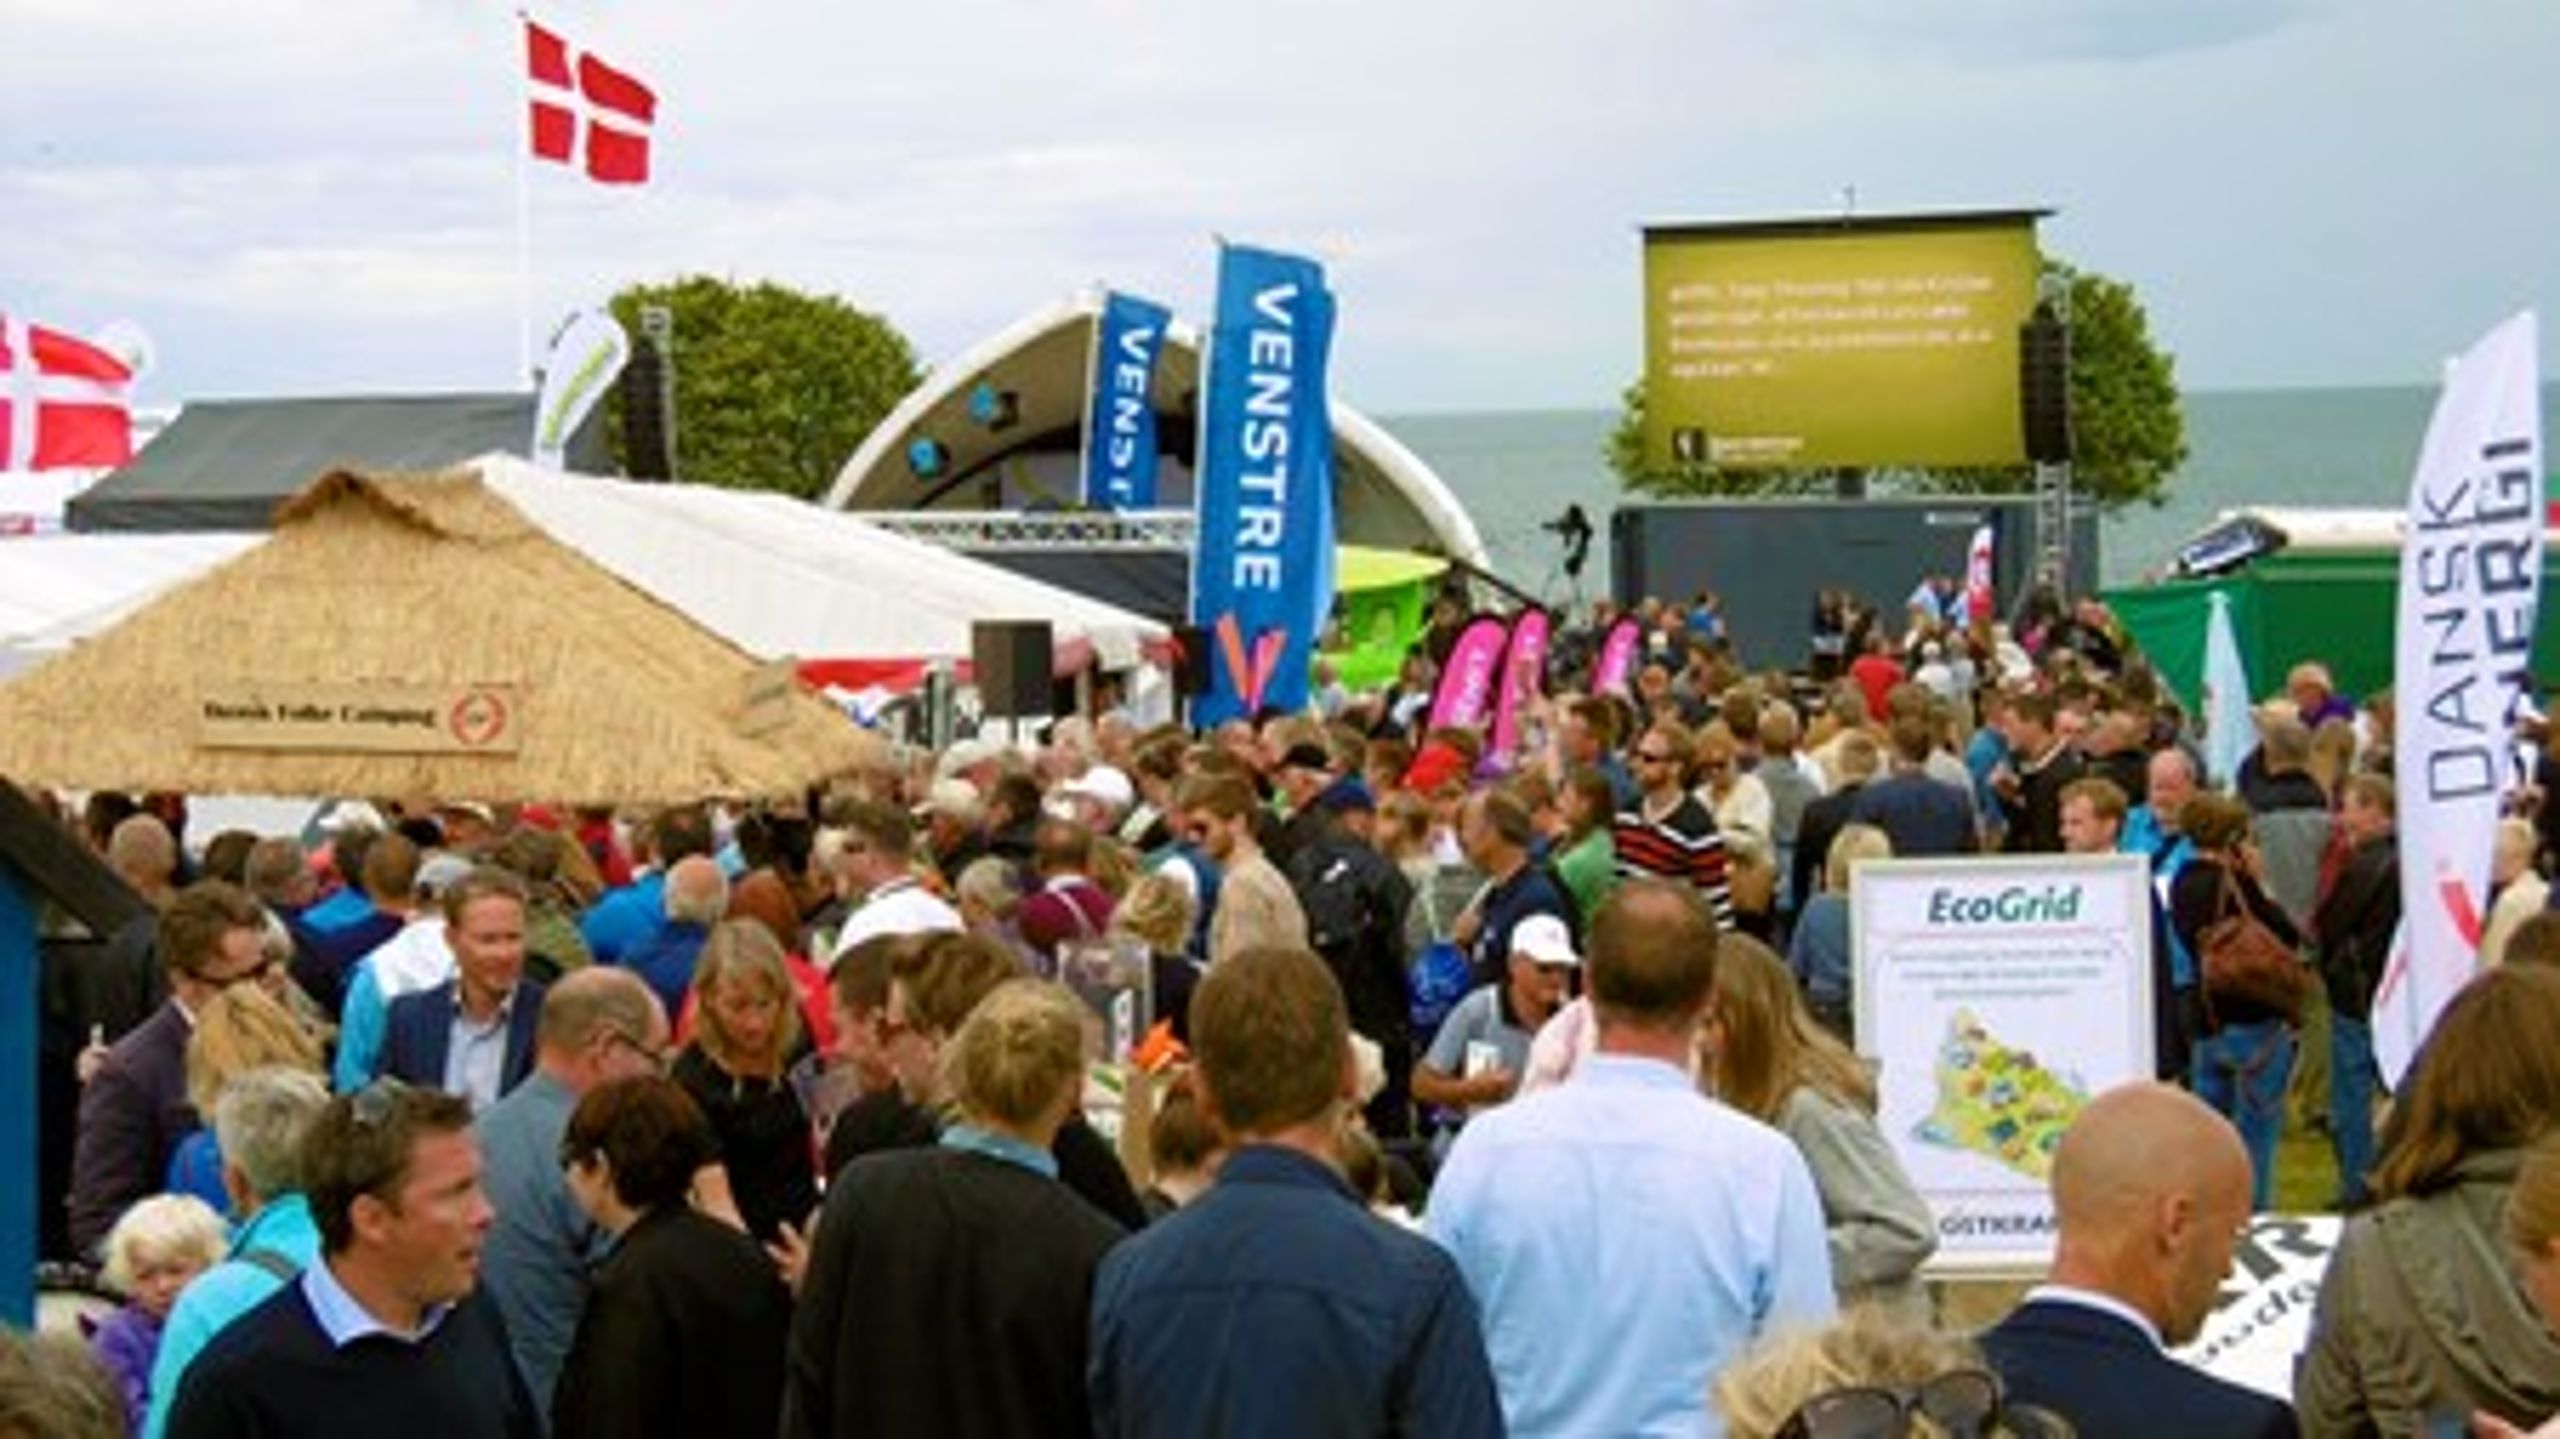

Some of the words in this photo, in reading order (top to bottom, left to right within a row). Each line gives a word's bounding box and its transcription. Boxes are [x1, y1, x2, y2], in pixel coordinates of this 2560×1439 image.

[1233, 282, 1299, 592] VENSTRE
[2418, 478, 2496, 801] DANSK
[1927, 885, 2083, 924] EcoGrid
